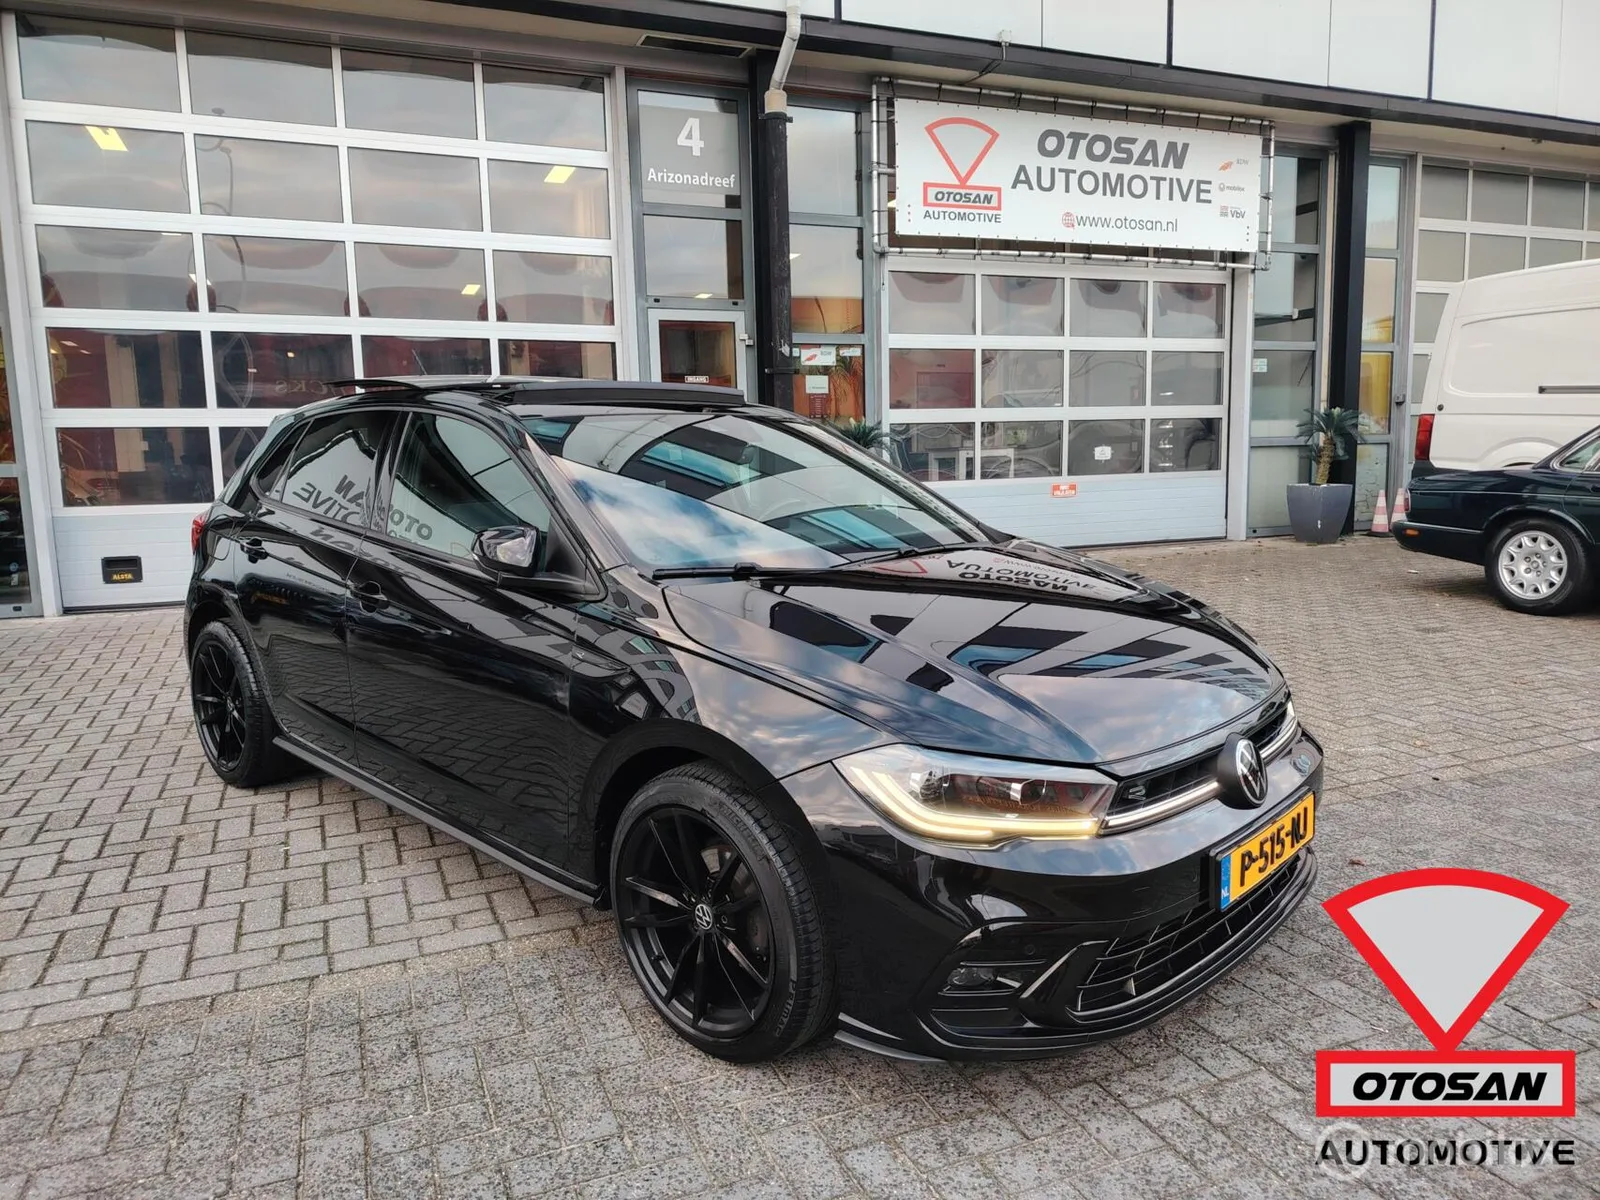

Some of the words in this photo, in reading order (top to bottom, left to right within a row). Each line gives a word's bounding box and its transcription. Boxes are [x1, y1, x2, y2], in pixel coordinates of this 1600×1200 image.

[676, 117, 704, 157] 4
[1037, 129, 1190, 170] OTOSAN
[647, 168, 736, 188] Arizonadreef
[1011, 164, 1212, 204] AUTOMOTIVE
[934, 191, 993, 204] OTOSAN
[923, 210, 1002, 223] AUTOMOTIVE
[1075, 215, 1178, 233] www.otosan.nl
[1221, 888, 1230, 898] NL
